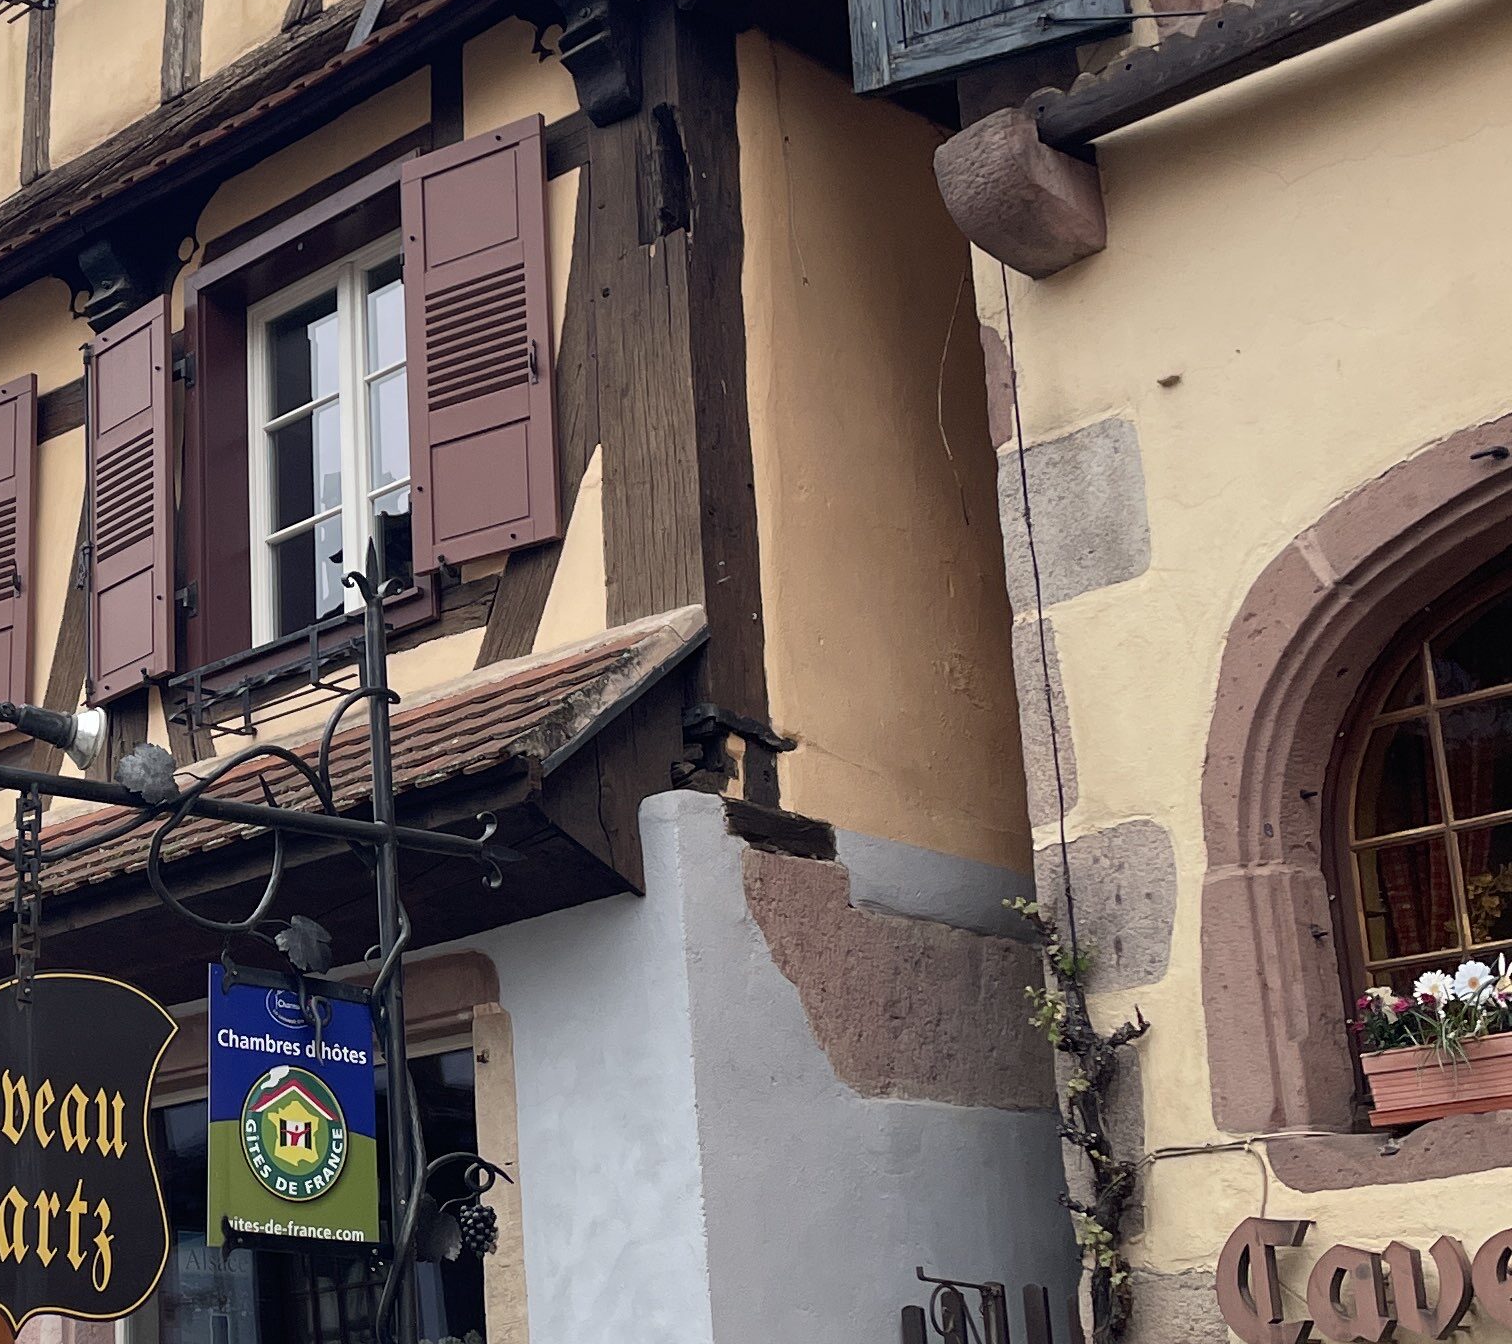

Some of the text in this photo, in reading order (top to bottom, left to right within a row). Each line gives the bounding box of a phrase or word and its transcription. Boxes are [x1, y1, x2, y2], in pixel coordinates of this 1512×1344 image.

[217, 1028, 368, 1065] Chambres dhôtes
[275, 1176, 298, 1196] DE
[304, 1128, 344, 1194] FRANCE
